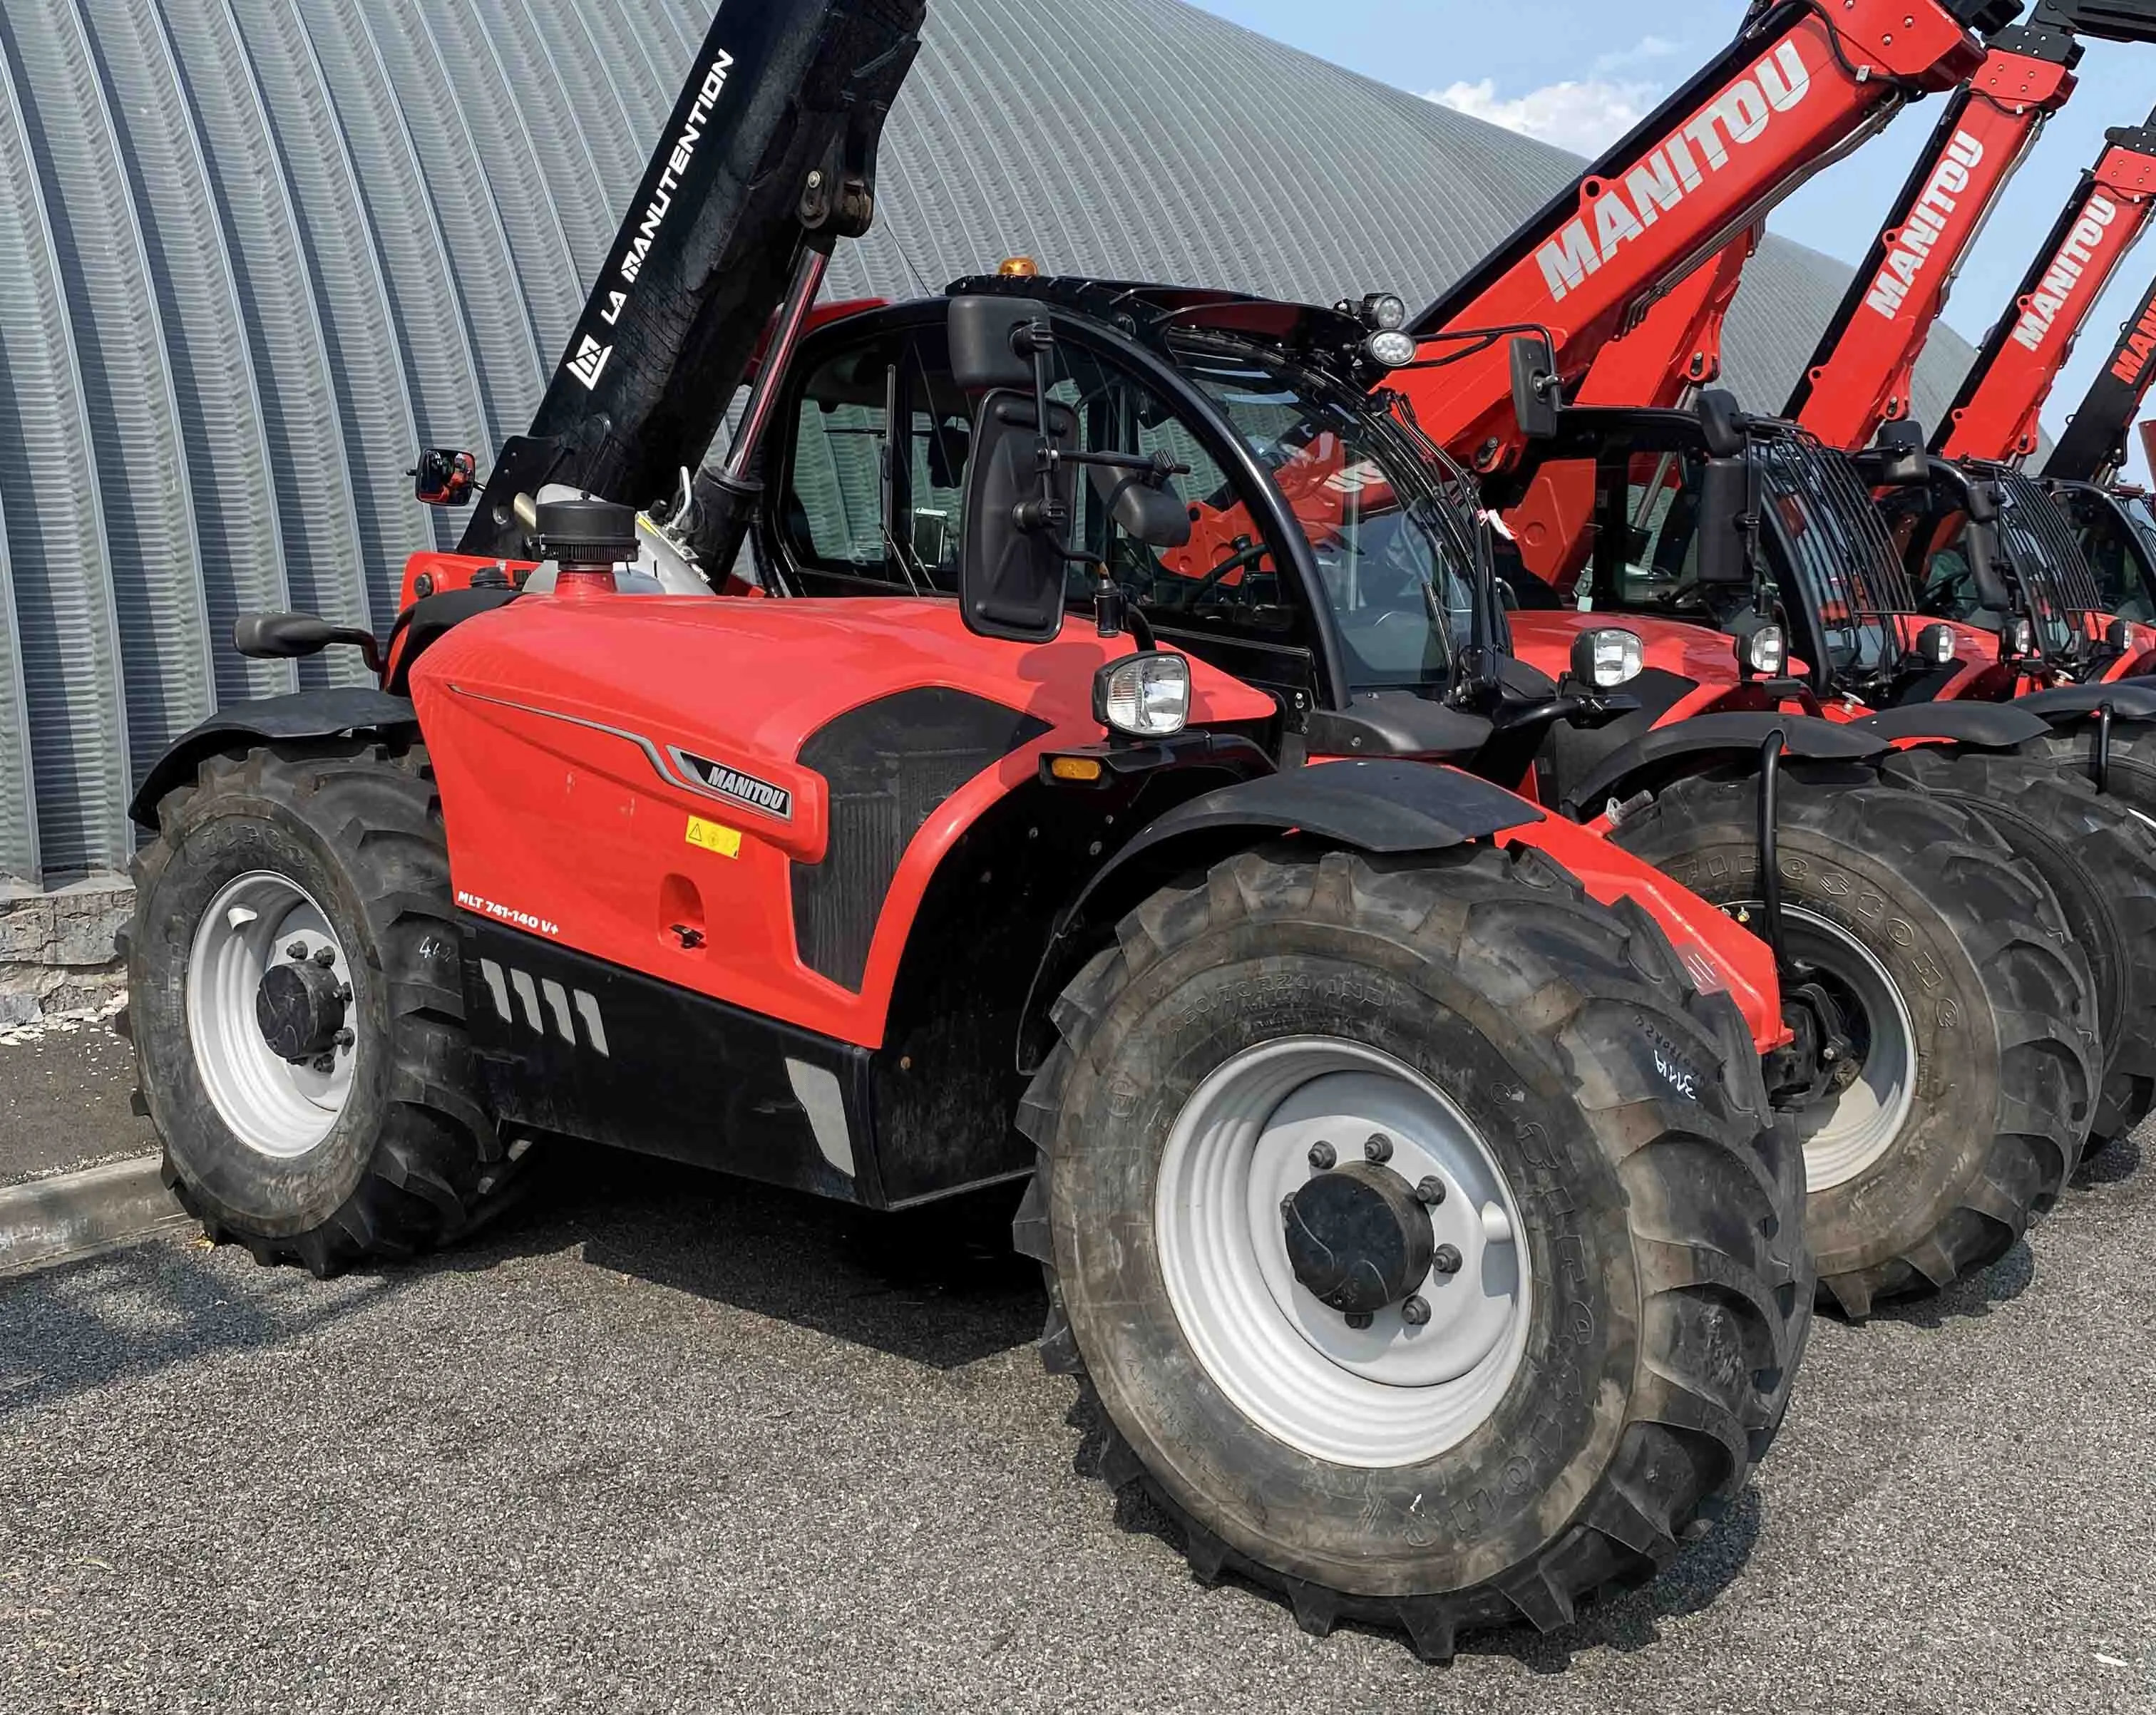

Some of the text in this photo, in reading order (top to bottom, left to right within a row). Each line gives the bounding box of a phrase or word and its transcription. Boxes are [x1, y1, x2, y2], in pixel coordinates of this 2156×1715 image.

[600, 290, 627, 326] LA
[621, 48, 734, 283] MANUTENTION
[1536, 38, 1810, 302] MANITOU
[1865, 130, 1984, 320] MANITOU
[2012, 193, 2117, 351] MANITOU
[707, 766, 788, 811] MANITOU
[458, 890, 559, 934] MLT 741-140 V+
